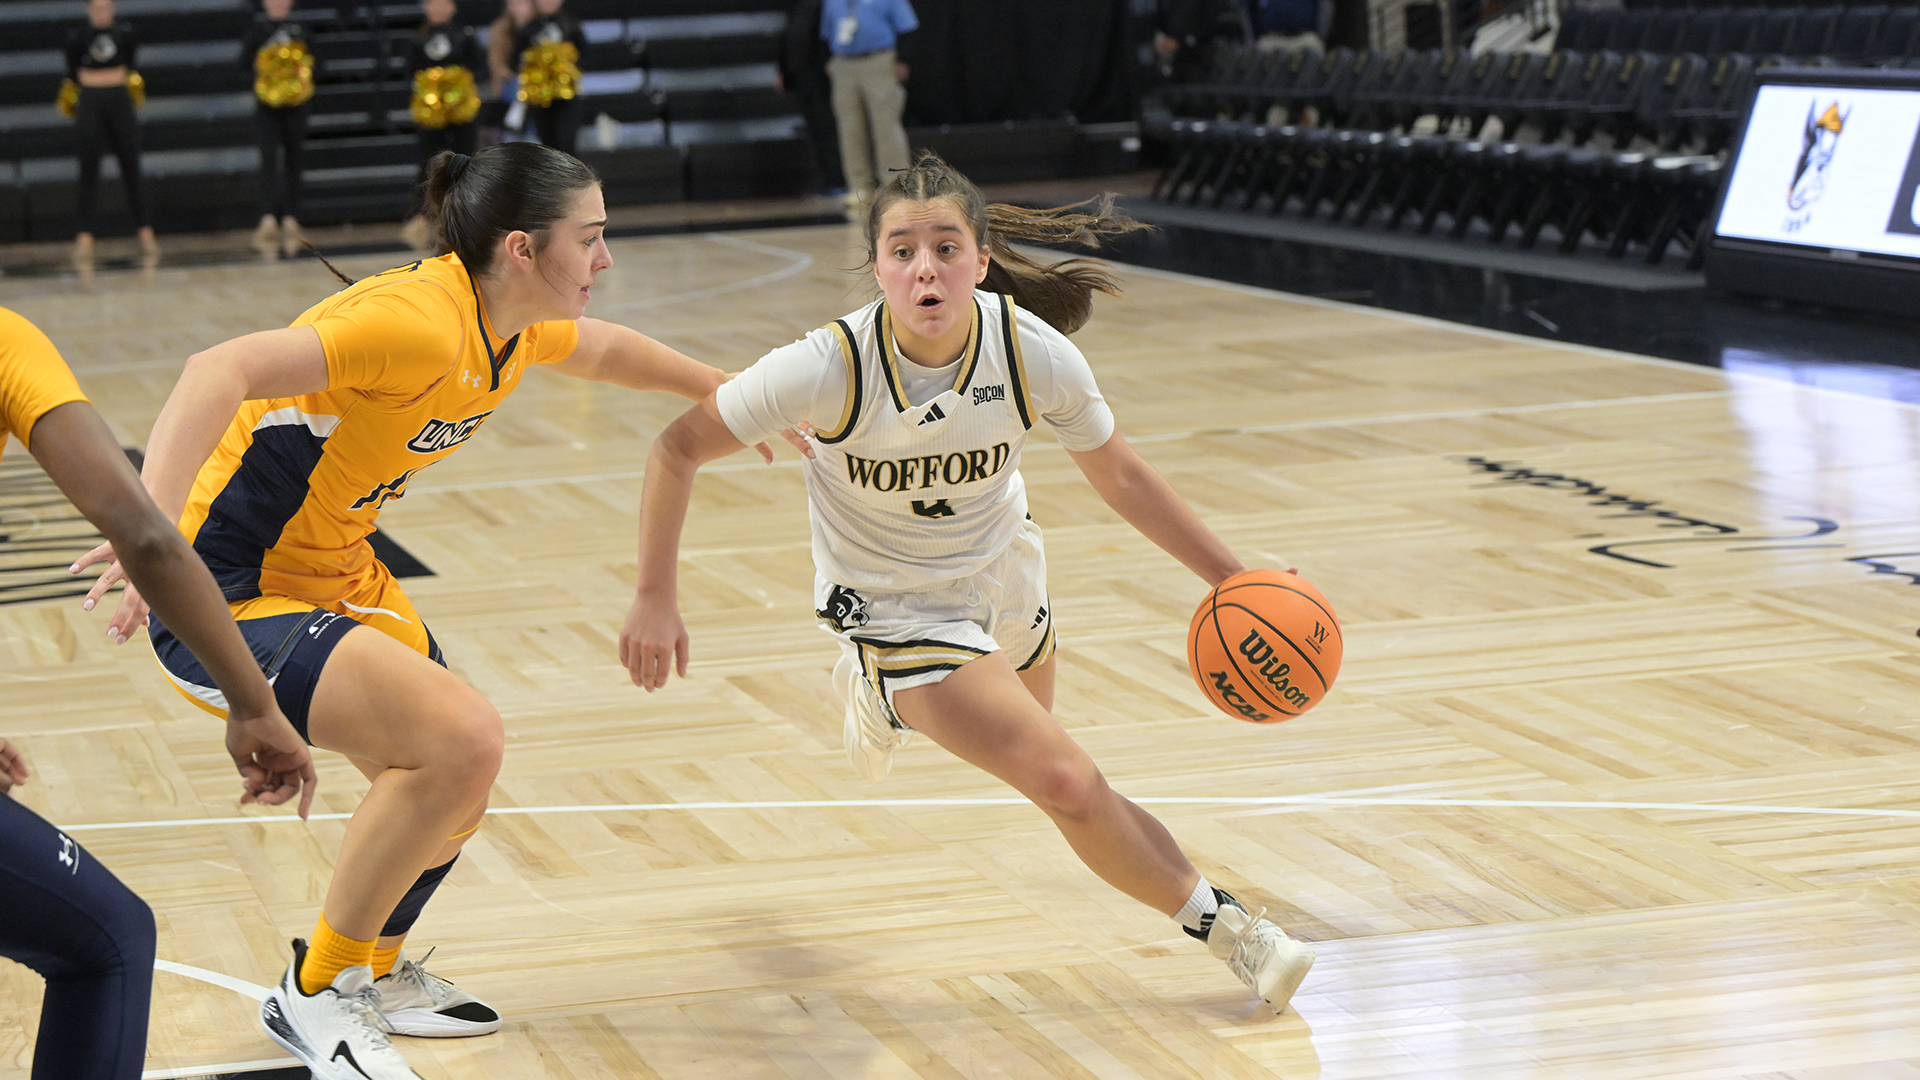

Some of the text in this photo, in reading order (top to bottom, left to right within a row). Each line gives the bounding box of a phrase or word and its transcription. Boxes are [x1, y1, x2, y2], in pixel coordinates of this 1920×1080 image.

[405, 410, 492, 454] UNC
[845, 442, 1011, 492] WOFFORD
[1315, 620, 1330, 643] W
[1239, 627, 1310, 709] Wilson
[1209, 671, 1271, 721] NCAA
